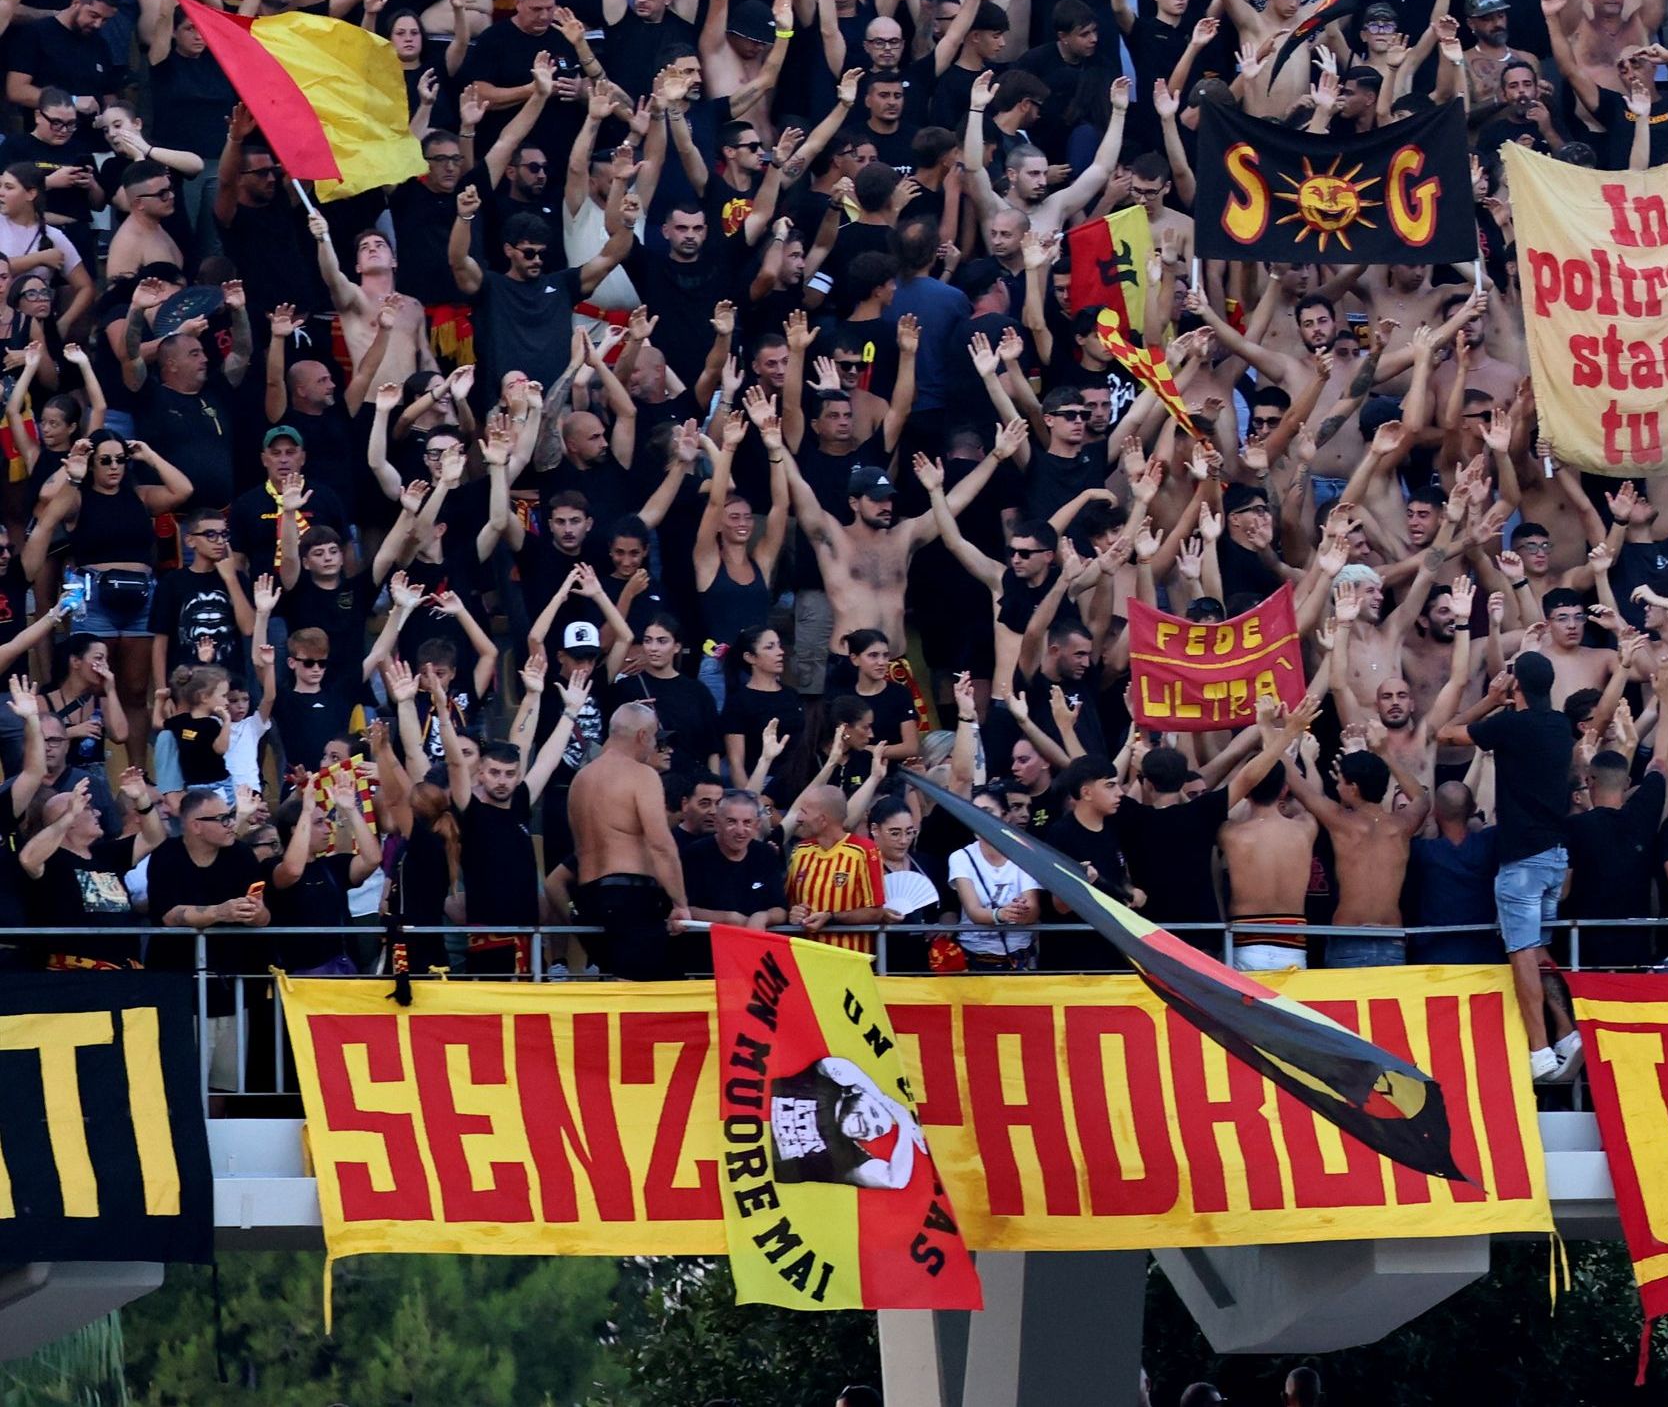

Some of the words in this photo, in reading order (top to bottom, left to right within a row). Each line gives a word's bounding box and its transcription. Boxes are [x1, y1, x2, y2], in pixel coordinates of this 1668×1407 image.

[1157, 617, 1263, 656] FEDE
[745, 951, 791, 1033] NON
[0, 1007, 181, 1219] TI
[306, 1011, 725, 1223] SENZ
[724, 1031, 781, 1219] MUORE
[752, 1216, 835, 1303] MAI
